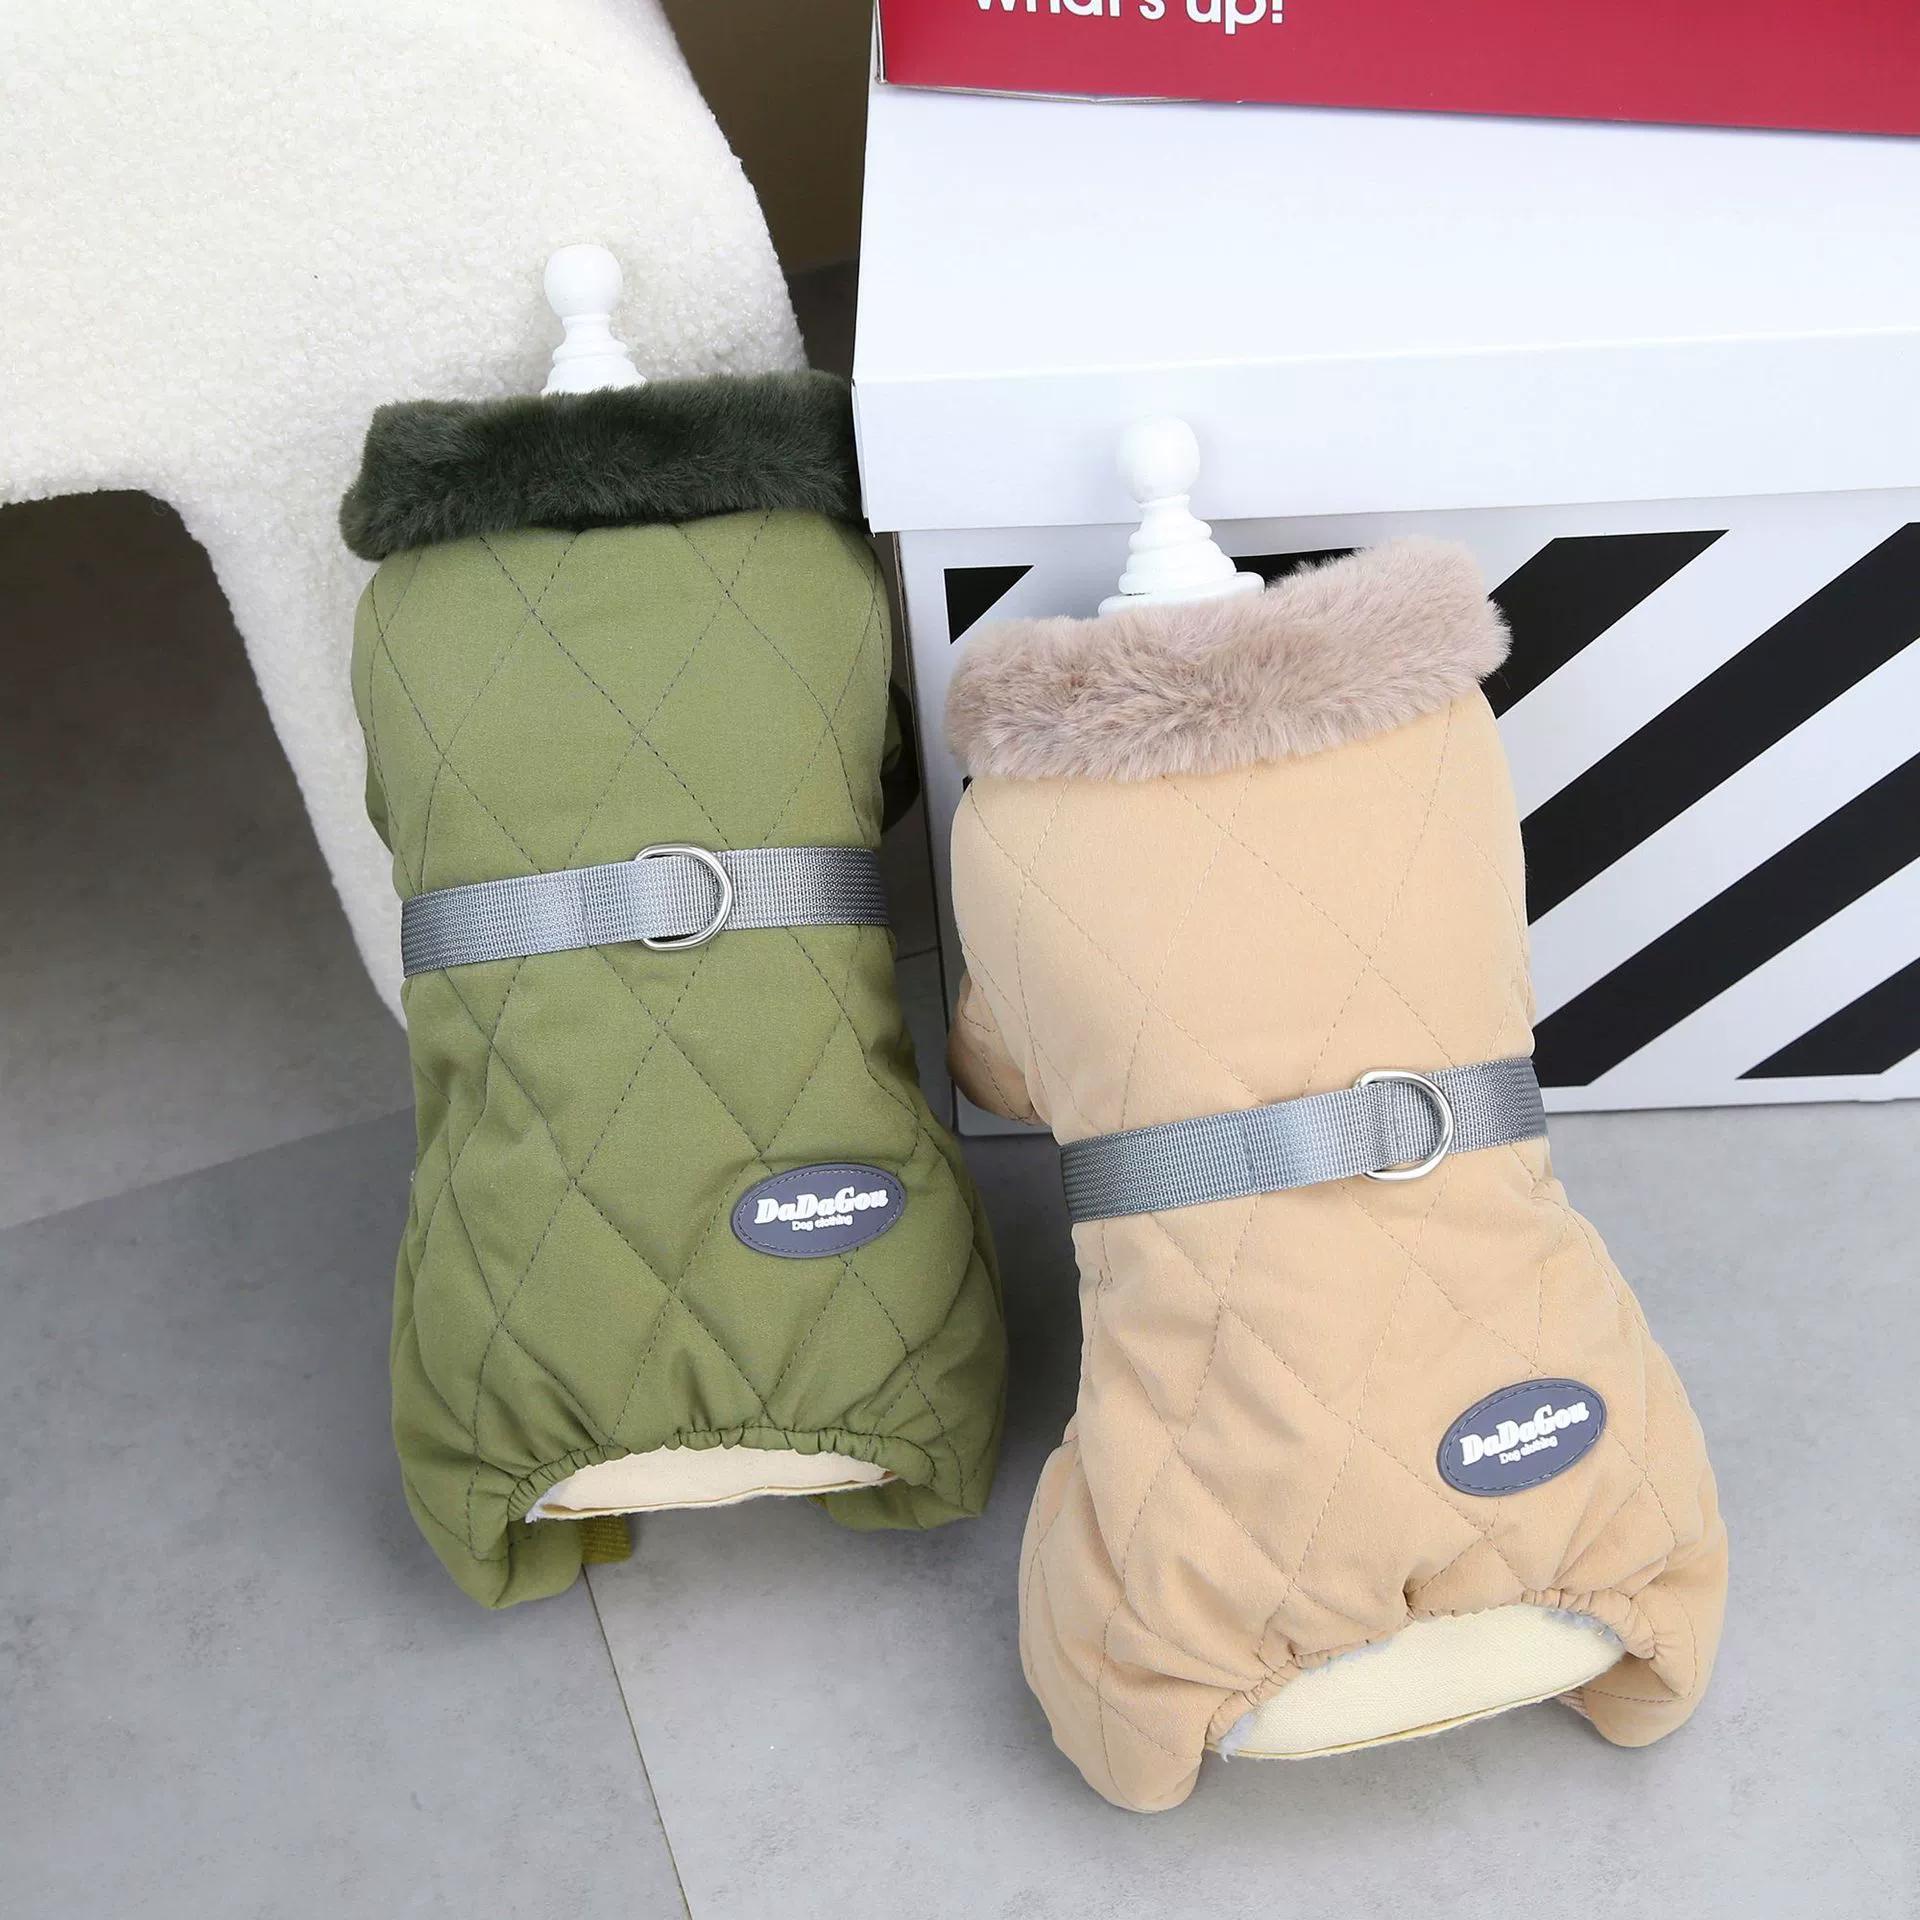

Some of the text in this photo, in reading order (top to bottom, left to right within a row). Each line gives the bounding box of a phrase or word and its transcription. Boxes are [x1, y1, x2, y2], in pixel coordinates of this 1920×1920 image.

[754, 1186, 889, 1224] DaDaGou
[791, 1220, 814, 1231] Dog
[1459, 1401, 1590, 1466] DaDaGou
[1498, 1449, 1522, 1465] Dog
